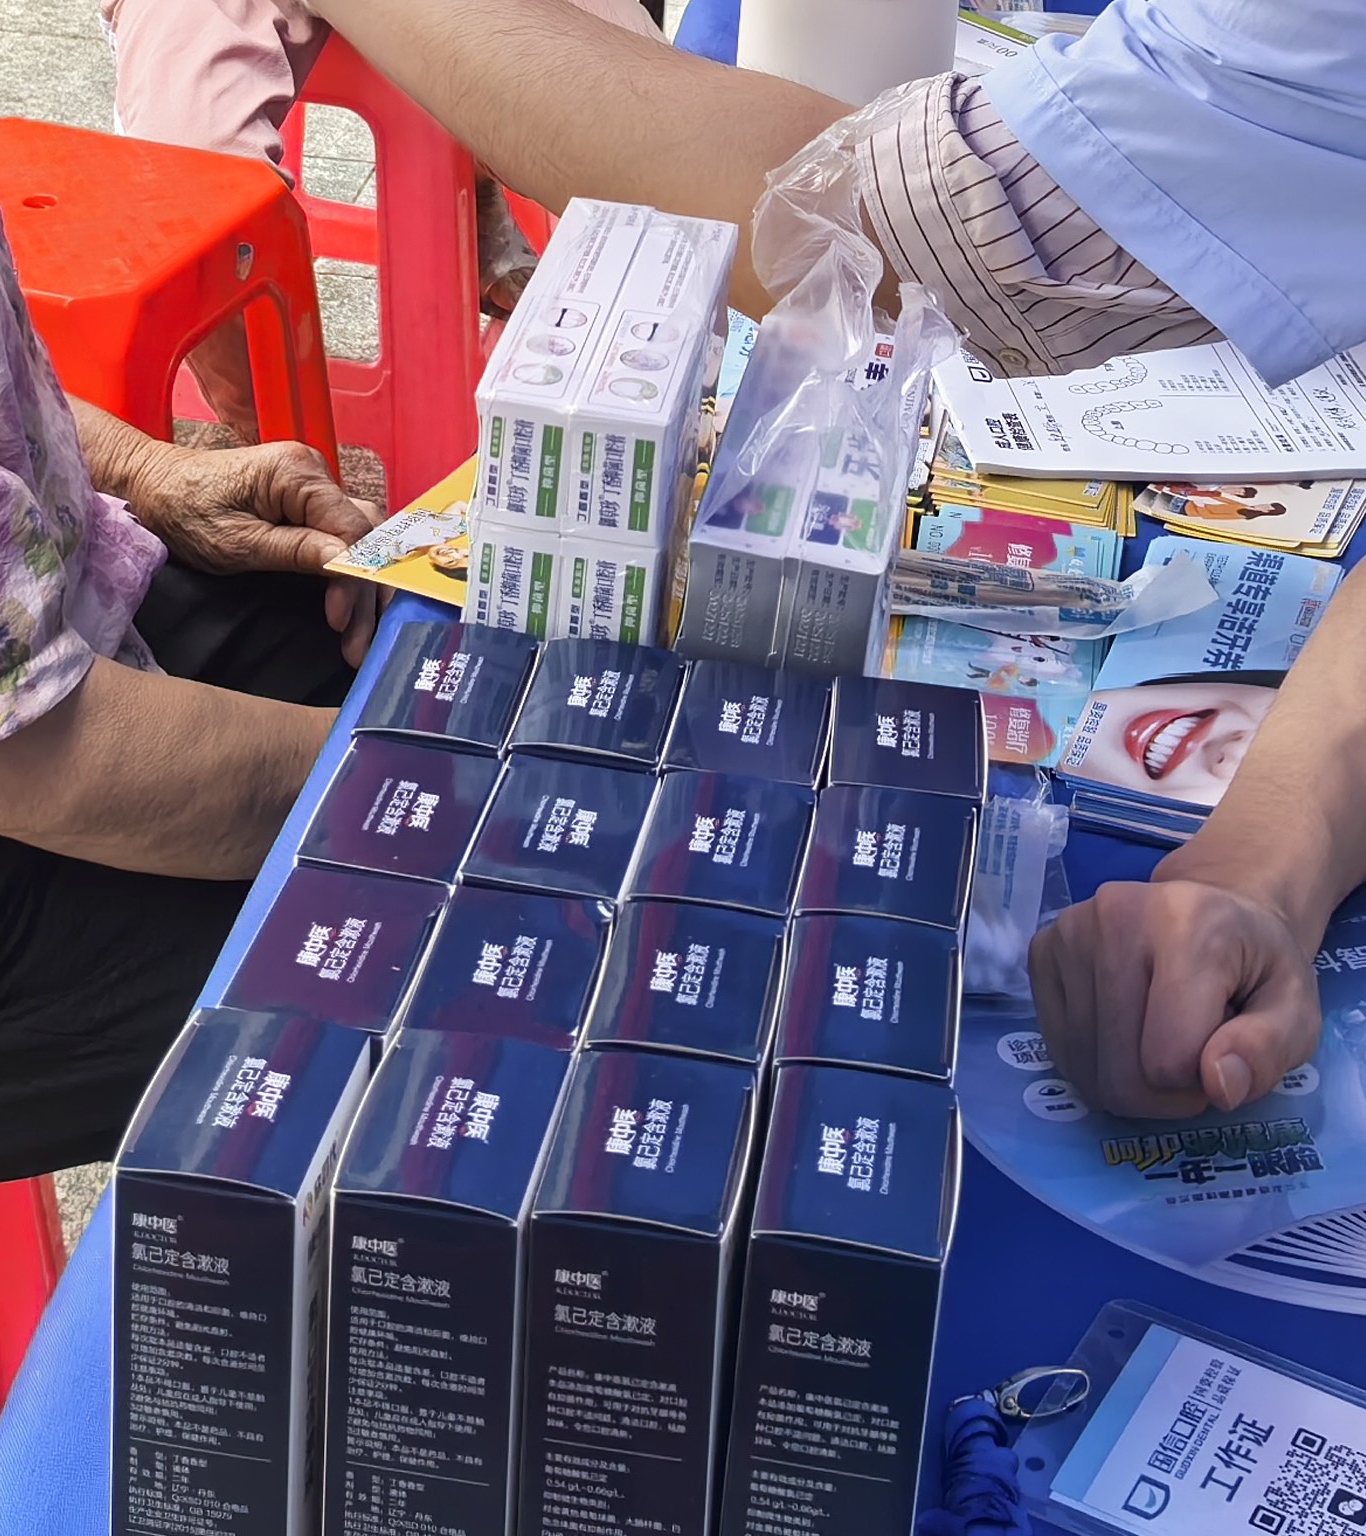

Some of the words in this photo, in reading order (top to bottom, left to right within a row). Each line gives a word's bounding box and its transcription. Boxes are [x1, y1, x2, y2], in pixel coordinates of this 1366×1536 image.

[1203, 550, 1285, 670] 渠道专享洁牙券
[1006, 706, 1032, 755] 修复治疗
[212, 1056, 267, 1129] 氯己定含漱液
[252, 1070, 291, 1121] 康中医
[427, 1077, 475, 1150] 氯己定含漱液
[464, 1091, 500, 1141] 康中医
[605, 1108, 637, 1155] 康中医
[633, 1098, 673, 1170] 氯己定含漱液
[818, 1125, 846, 1175] 康中医
[847, 1116, 879, 1191] 氯己定含漱液
[1101, 1117, 1316, 1172] 呵护眼健康
[132, 1212, 177, 1234] 康中医
[351, 1235, 398, 1257] 康中医
[131, 1242, 230, 1276] 氯己定含漱液
[350, 1265, 451, 1298] 氯己定含漱液
[554, 1268, 602, 1290] 康中医
[554, 1303, 657, 1336] 氯己定含漱液
[770, 1289, 819, 1312] 康中医
[768, 1323, 873, 1358] 氯己定含漱液
[1147, 1401, 1208, 1474] 国信口腔
[1196, 1413, 1221, 1448] DENTAL
[1200, 1412, 1275, 1503] 工作证
